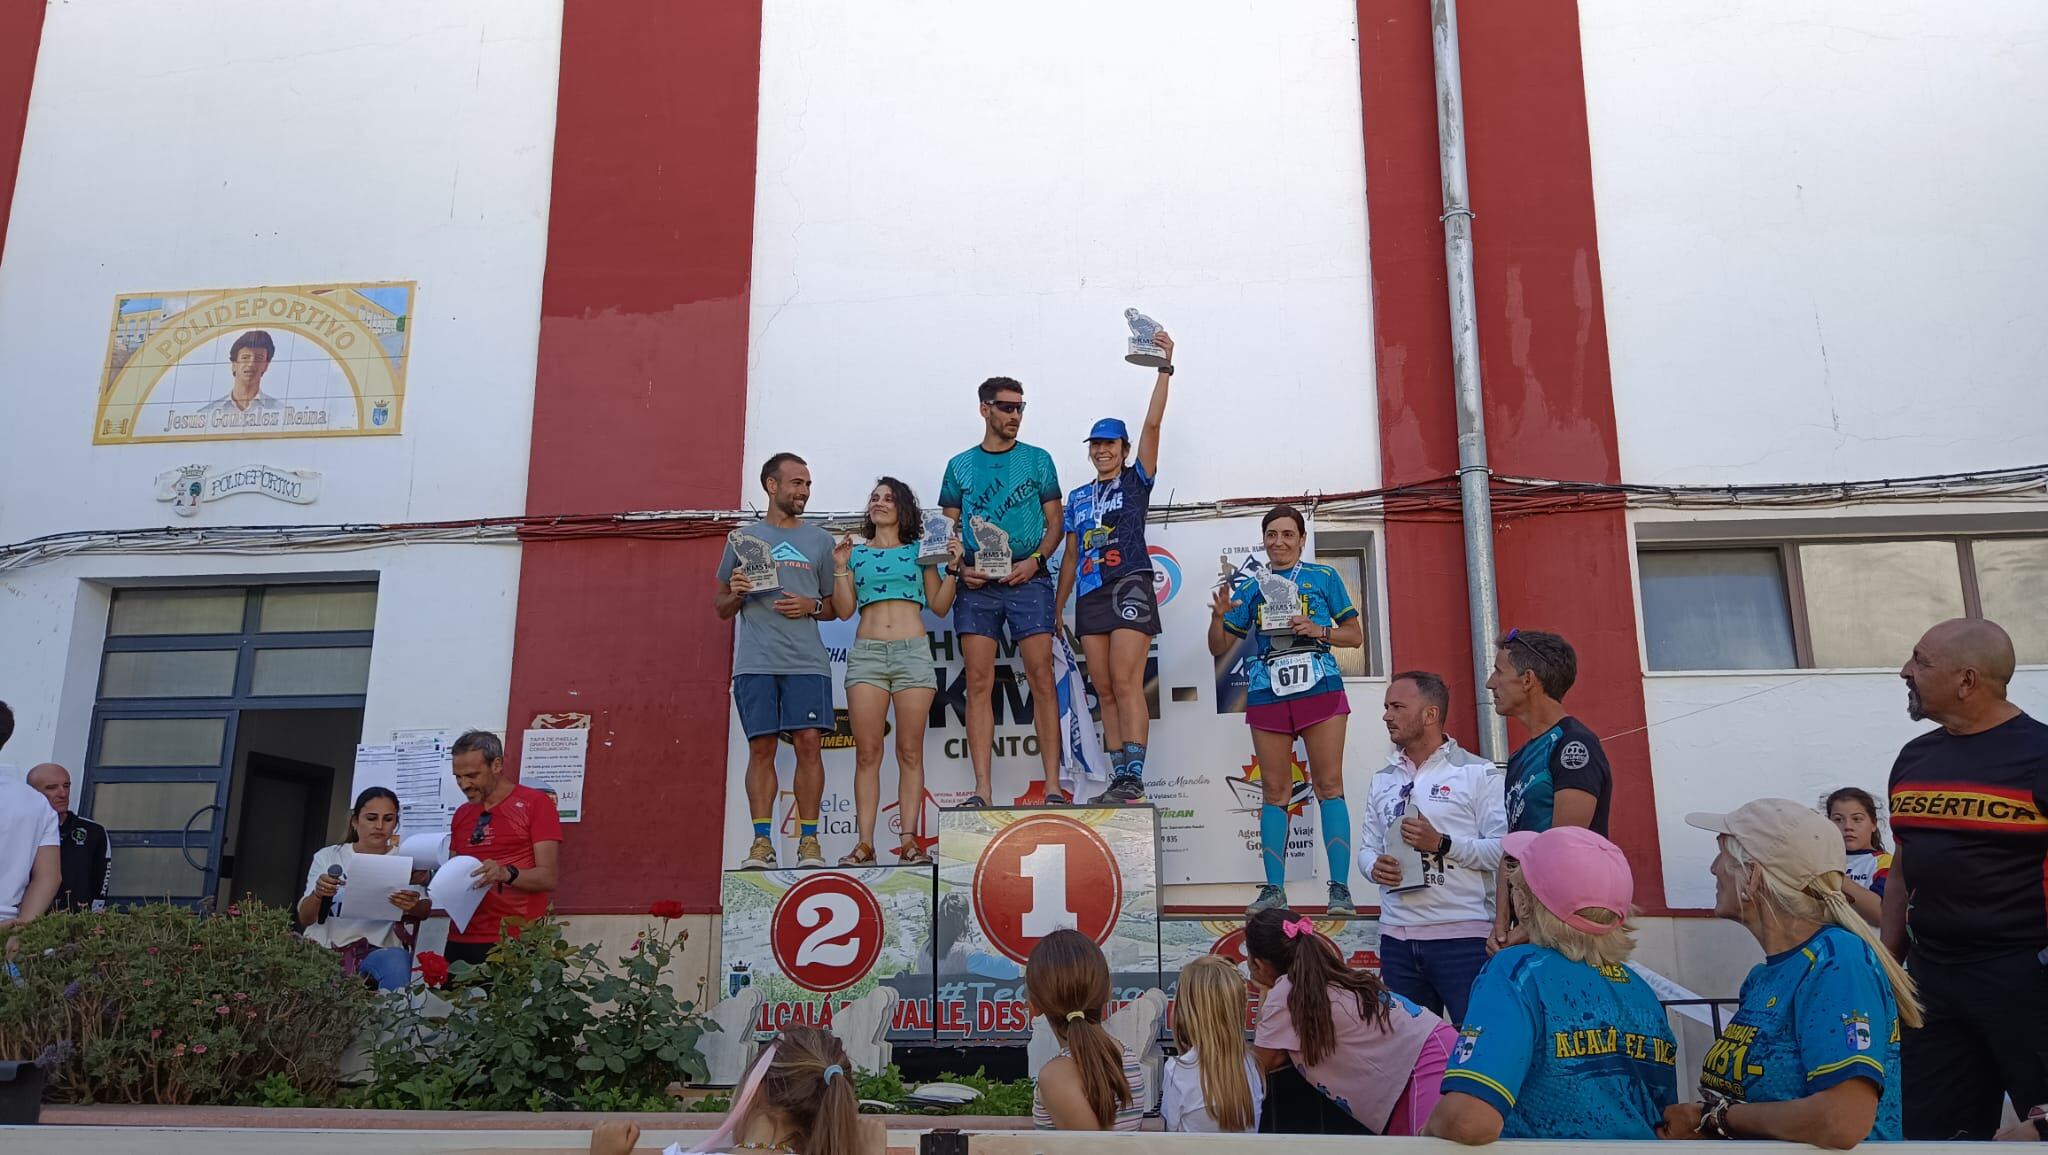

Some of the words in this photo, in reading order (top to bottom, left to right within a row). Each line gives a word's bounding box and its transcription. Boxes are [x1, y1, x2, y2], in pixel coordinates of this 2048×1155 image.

[155, 297, 356, 360] POLIDEPORTIVO
[284, 406, 327, 426] Reina
[212, 469, 300, 499] POLIDEPORTIVO
[1252, 545, 1266, 553] RUN
[1278, 664, 1308, 687] 677
[1891, 793, 2036, 821] DESÉRTICA
[1019, 843, 1079, 937] 1
[795, 892, 861, 967] 2
